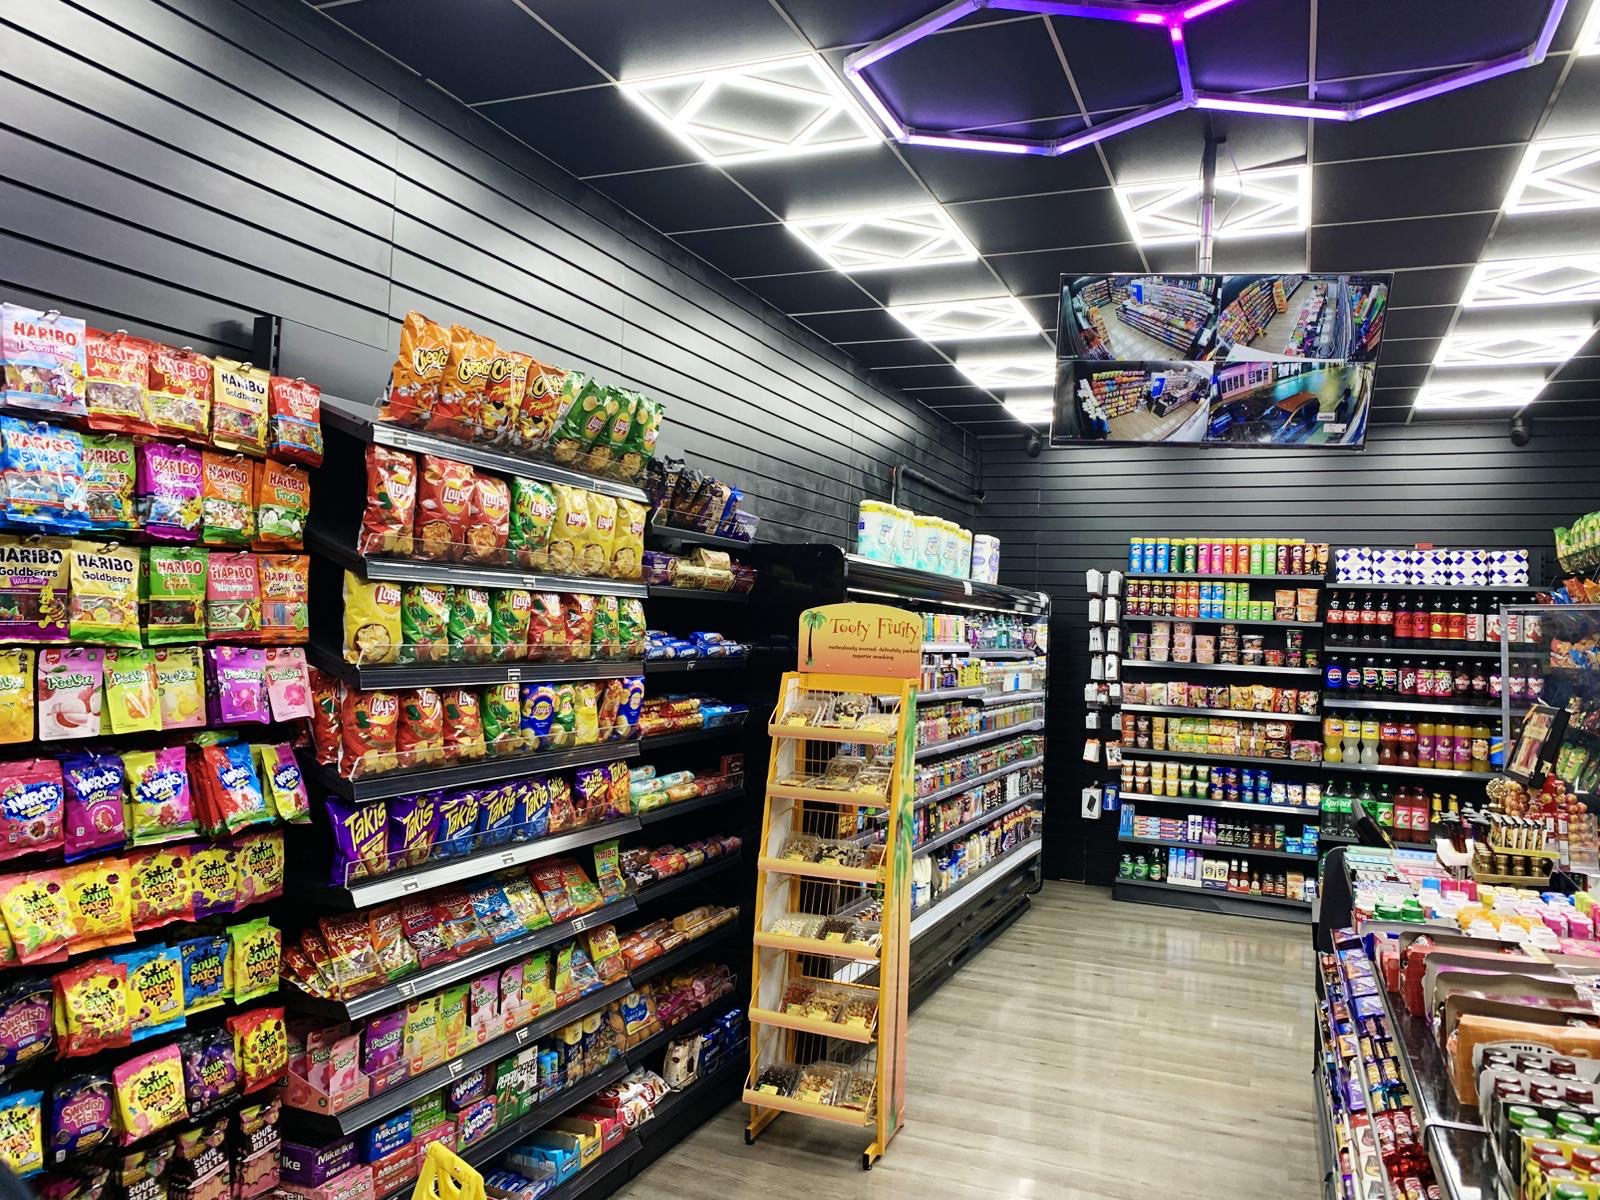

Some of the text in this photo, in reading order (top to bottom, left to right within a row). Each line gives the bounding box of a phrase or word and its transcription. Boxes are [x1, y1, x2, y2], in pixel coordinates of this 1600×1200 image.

[13, 320, 77, 346] HARIBO
[158, 356, 208, 380] HARIBO
[490, 358, 525, 381] Cheetos
[221, 373, 265, 395] HARIBO
[225, 387, 263, 404] Goldbears
[269, 472, 305, 492] HARIBO
[0, 567, 58, 577] Goldbears
[77, 554, 133, 573] HARIBO
[156, 559, 203, 575] HARIBO
[82, 571, 132, 584] Goldbears
[830, 616, 919, 644] Tooty Fruity
[608, 761, 628, 787] Takis
[486, 790, 516, 831] Takis
[523, 784, 548, 824] Takis
[344, 802, 386, 852] Takis
[402, 803, 434, 849] Takis
[445, 802, 478, 841] Takis
[249, 848, 273, 863] SOUR
[596, 849, 615, 861] HARIBO
[200, 867, 228, 879] SOUR
[250, 858, 276, 873] PATCH
[142, 872, 174, 889] SOUR
[144, 880, 177, 898] PATCH
[201, 875, 229, 889] PATCH
[80, 890, 111, 904] SOUR
[80, 897, 114, 915] PATCH
[190, 955, 221, 975] SOUR
[247, 946, 276, 965] SOUR
[189, 965, 222, 986] PATCH
[247, 957, 280, 980] PATCH
[138, 970, 171, 990] SOUR
[139, 980, 176, 1003] PATCH
[0, 1006, 46, 1038] Swedish
[11, 1021, 38, 1041] Fish
[258, 1036, 277, 1051] SOUR
[259, 1044, 280, 1060] PATCH
[201, 1060, 225, 1076] SOUR
[203, 1067, 228, 1085] PATCH
[137, 1075, 171, 1098] SOUR
[139, 1083, 177, 1110] PATCH
[62, 1096, 105, 1123] Swedish
[73, 1110, 100, 1129] Fish
[250, 1124, 273, 1144] SOUR
[252, 1130, 278, 1152] BELTS
[374, 1120, 410, 1143] Mike Ike
[317, 1141, 355, 1166] Mike Ike
[380, 1138, 405, 1154] Mike Ike
[193, 1148, 217, 1169] SOUR
[195, 1152, 224, 1177] BELTS
[282, 1157, 301, 1171] Ike
[326, 1161, 351, 1178] Mike Ike
[378, 1164, 397, 1178] Mike
[128, 1177, 156, 1197] SOUR
[332, 1180, 371, 1200] Mike Ike
